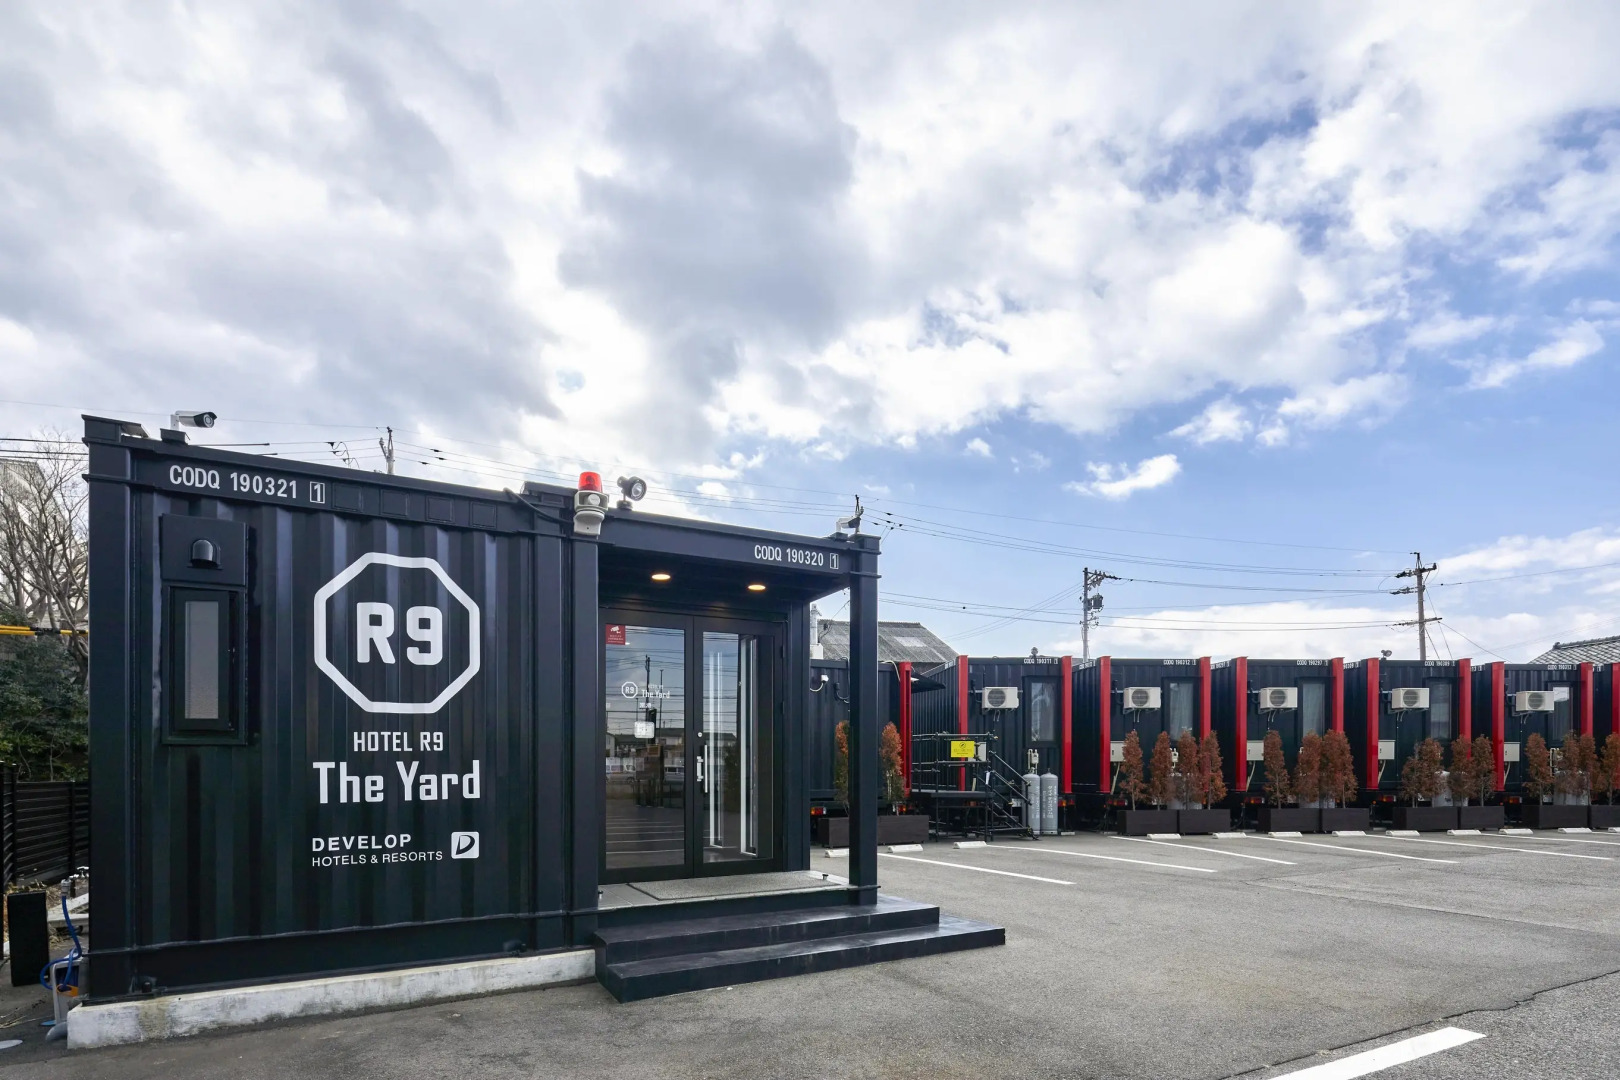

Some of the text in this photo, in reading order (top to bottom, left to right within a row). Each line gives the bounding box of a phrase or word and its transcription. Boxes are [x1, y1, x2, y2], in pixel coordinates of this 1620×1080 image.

[169, 464, 323, 502] CODQ 190321 1
[754, 544, 782, 561] CODQ
[786, 548, 824, 566] 190320
[357, 602, 443, 665] R9
[641, 690, 670, 699] The Yard
[353, 731, 444, 751] HOTEL R9
[312, 759, 480, 804] The Yard
[312, 833, 412, 852] DEVELOP
[312, 851, 443, 867] HOTELS & RESORTS
